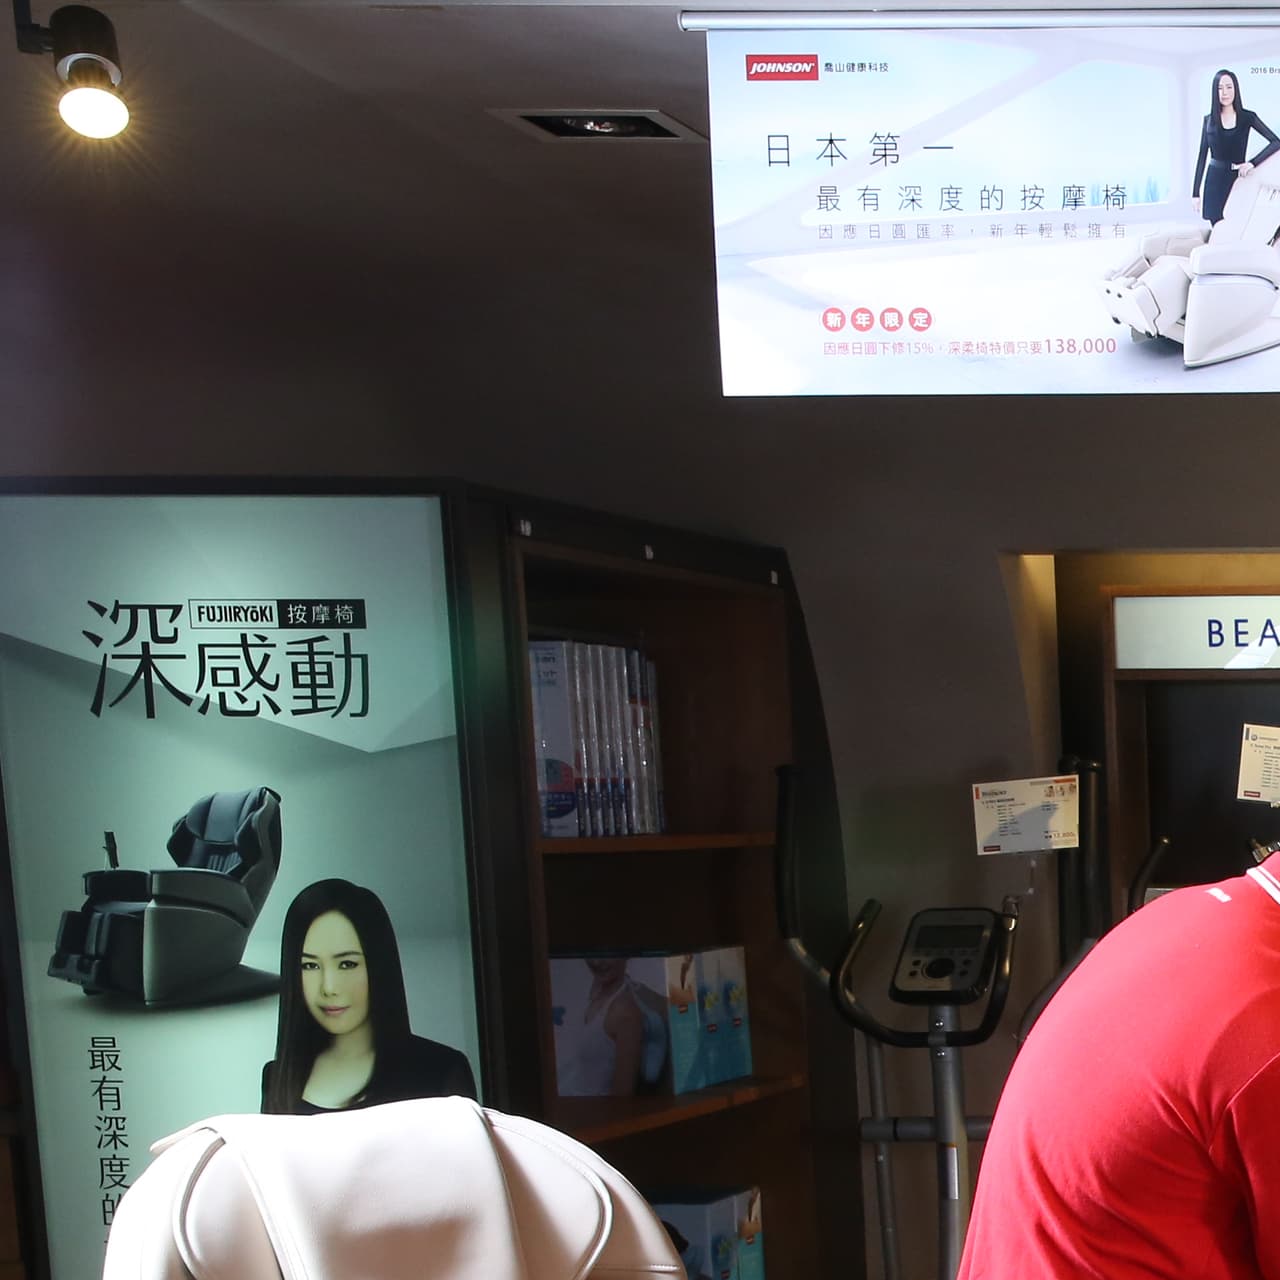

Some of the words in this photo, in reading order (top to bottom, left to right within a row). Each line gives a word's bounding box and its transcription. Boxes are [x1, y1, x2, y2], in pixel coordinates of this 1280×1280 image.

[750, 62, 815, 74] JOHNSON
[824, 61, 889, 73] 喬山健康科技
[767, 132, 954, 167] 日本第一
[816, 184, 1128, 211] 最有深度的按摩椅
[825, 311, 930, 328] 新年限定
[287, 603, 354, 625] 按摩椅
[82, 599, 370, 720] 深感動
[87, 1036, 131, 1226] 最有深度的
